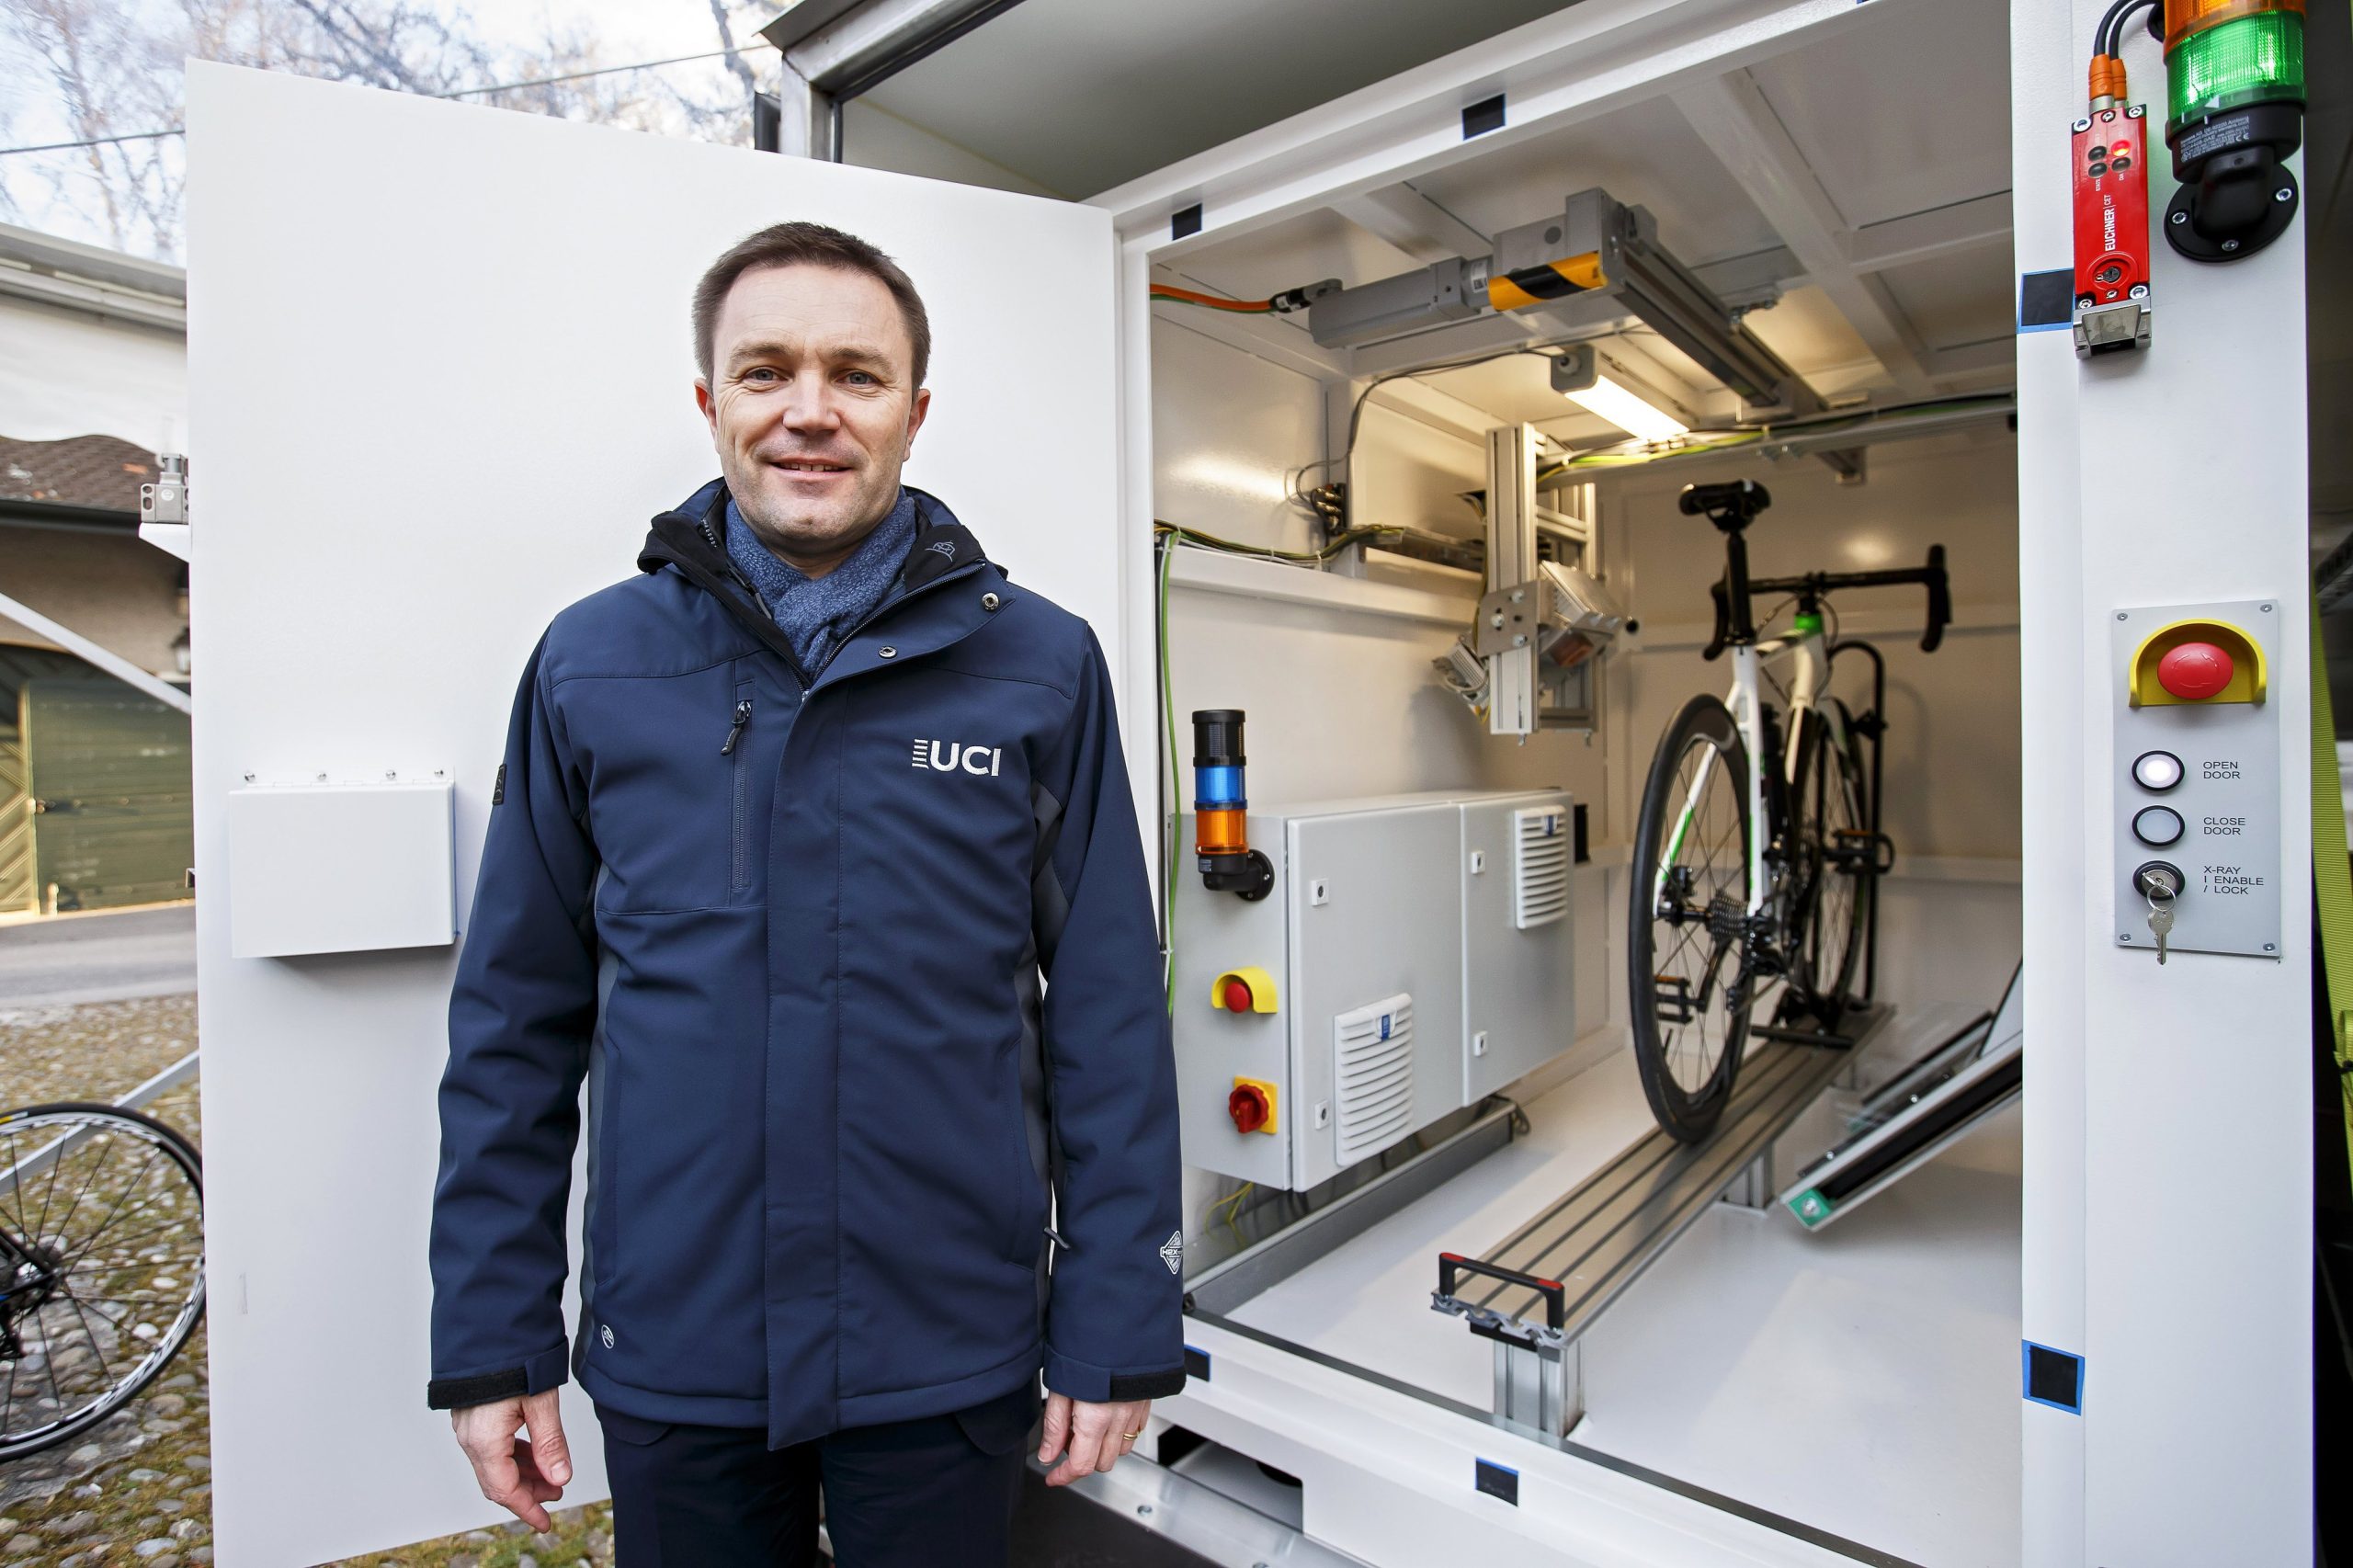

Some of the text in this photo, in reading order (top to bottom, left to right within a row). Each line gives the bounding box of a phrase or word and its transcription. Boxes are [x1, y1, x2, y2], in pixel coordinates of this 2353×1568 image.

[2103, 194, 2116, 251] EUCHNER CET
[2203, 761, 2238, 769] OPEN
[2203, 771, 2241, 779] DOOR
[2203, 817, 2246, 826] CLOSE
[2203, 826, 2241, 835] DOOR
[2203, 865, 2241, 874] X-RAY
[2214, 876, 2264, 885] ENABLE
[2214, 885, 2249, 895] LOCK
